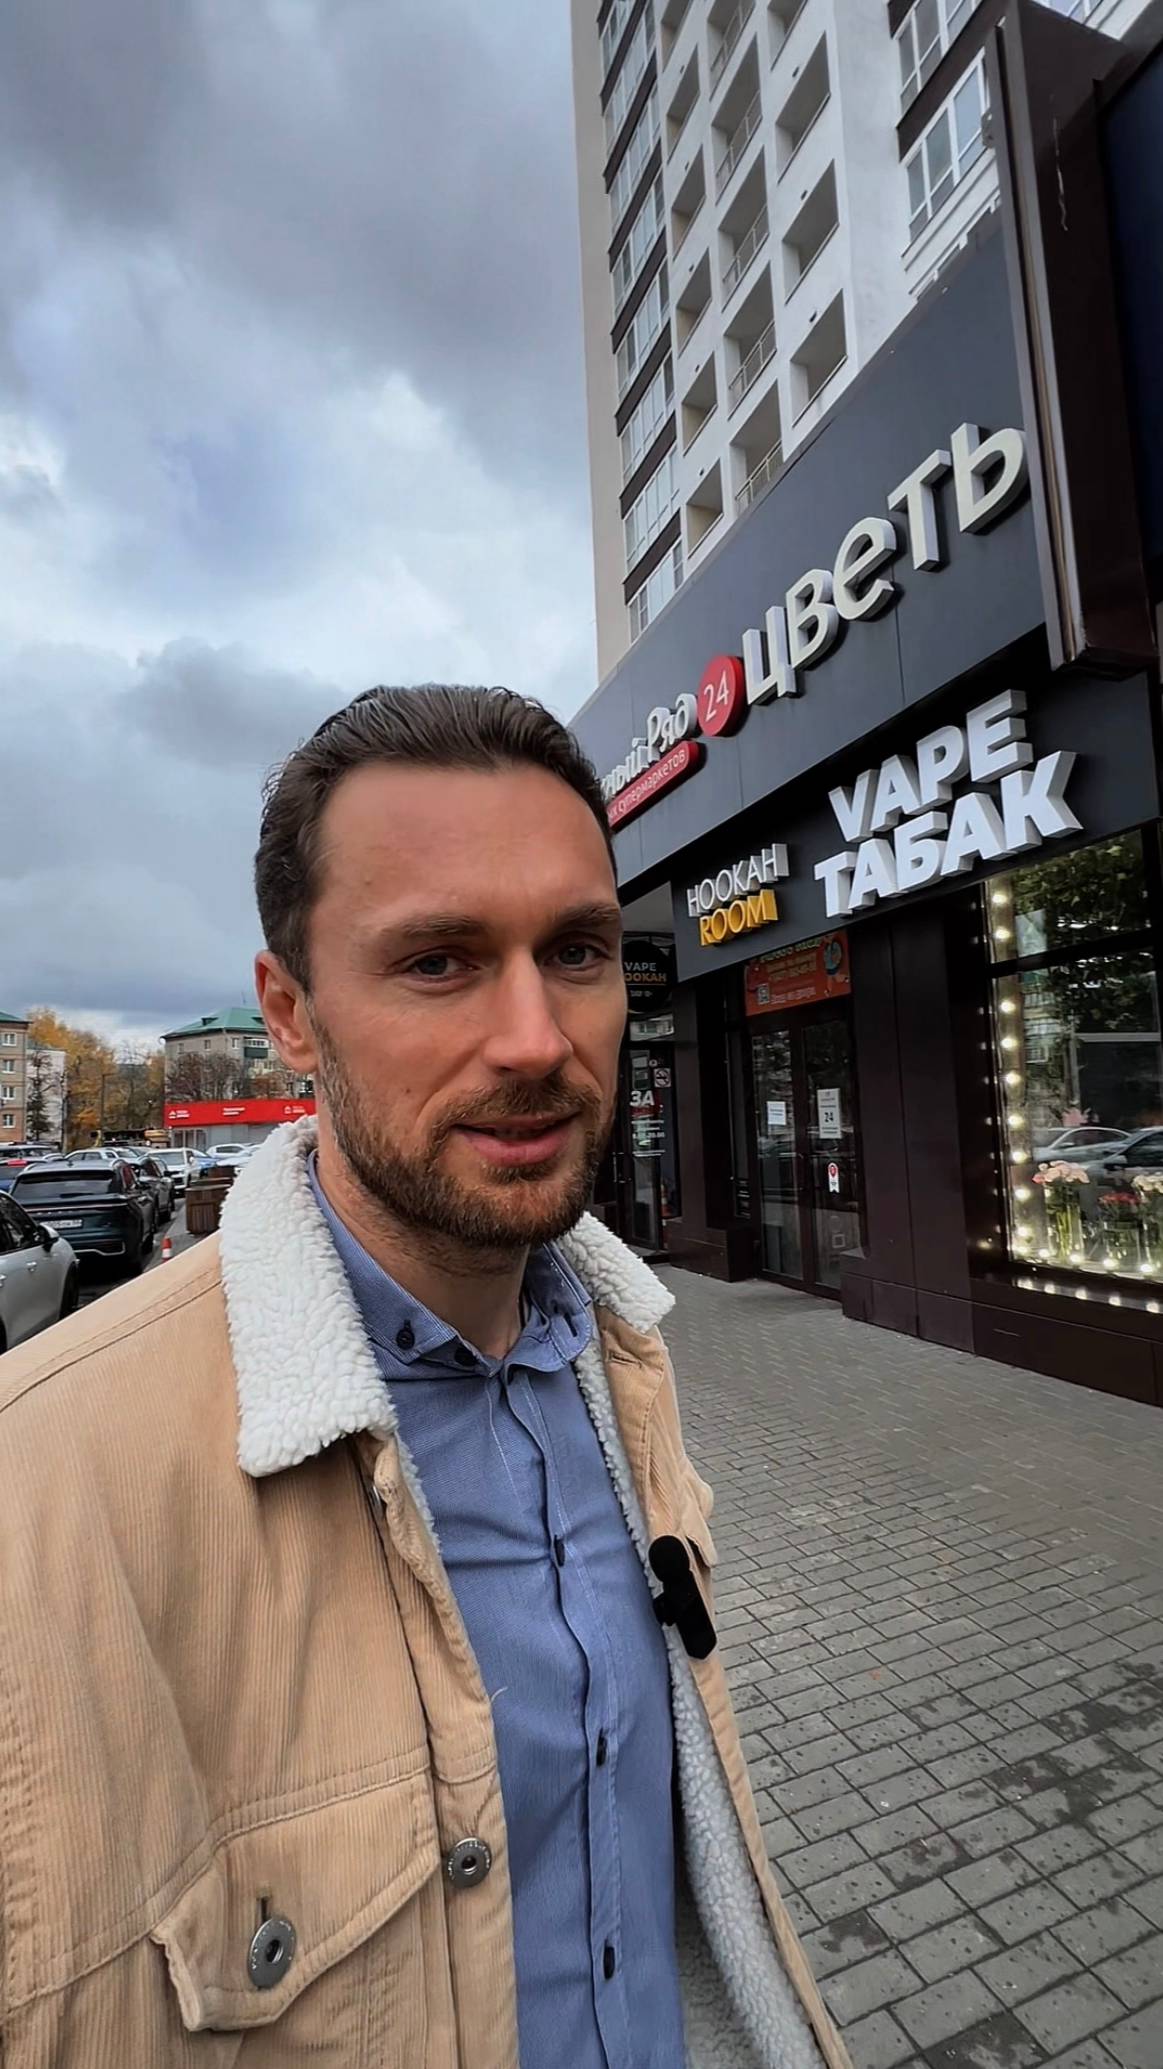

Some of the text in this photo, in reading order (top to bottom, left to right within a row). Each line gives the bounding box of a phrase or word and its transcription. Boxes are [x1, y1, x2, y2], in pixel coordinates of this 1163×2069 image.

[647, 692, 698, 764] Ряд
[704, 669, 730, 723] 24
[618, 748, 686, 816] супермаркетов
[828, 688, 1034, 843] VAPE
[814, 750, 1084, 918] ТАБАК
[687, 843, 789, 918] HOOKAH
[700, 888, 778, 947] ROOM
[623, 961, 657, 972] VAPE
[624, 972, 668, 983] OOKAH
